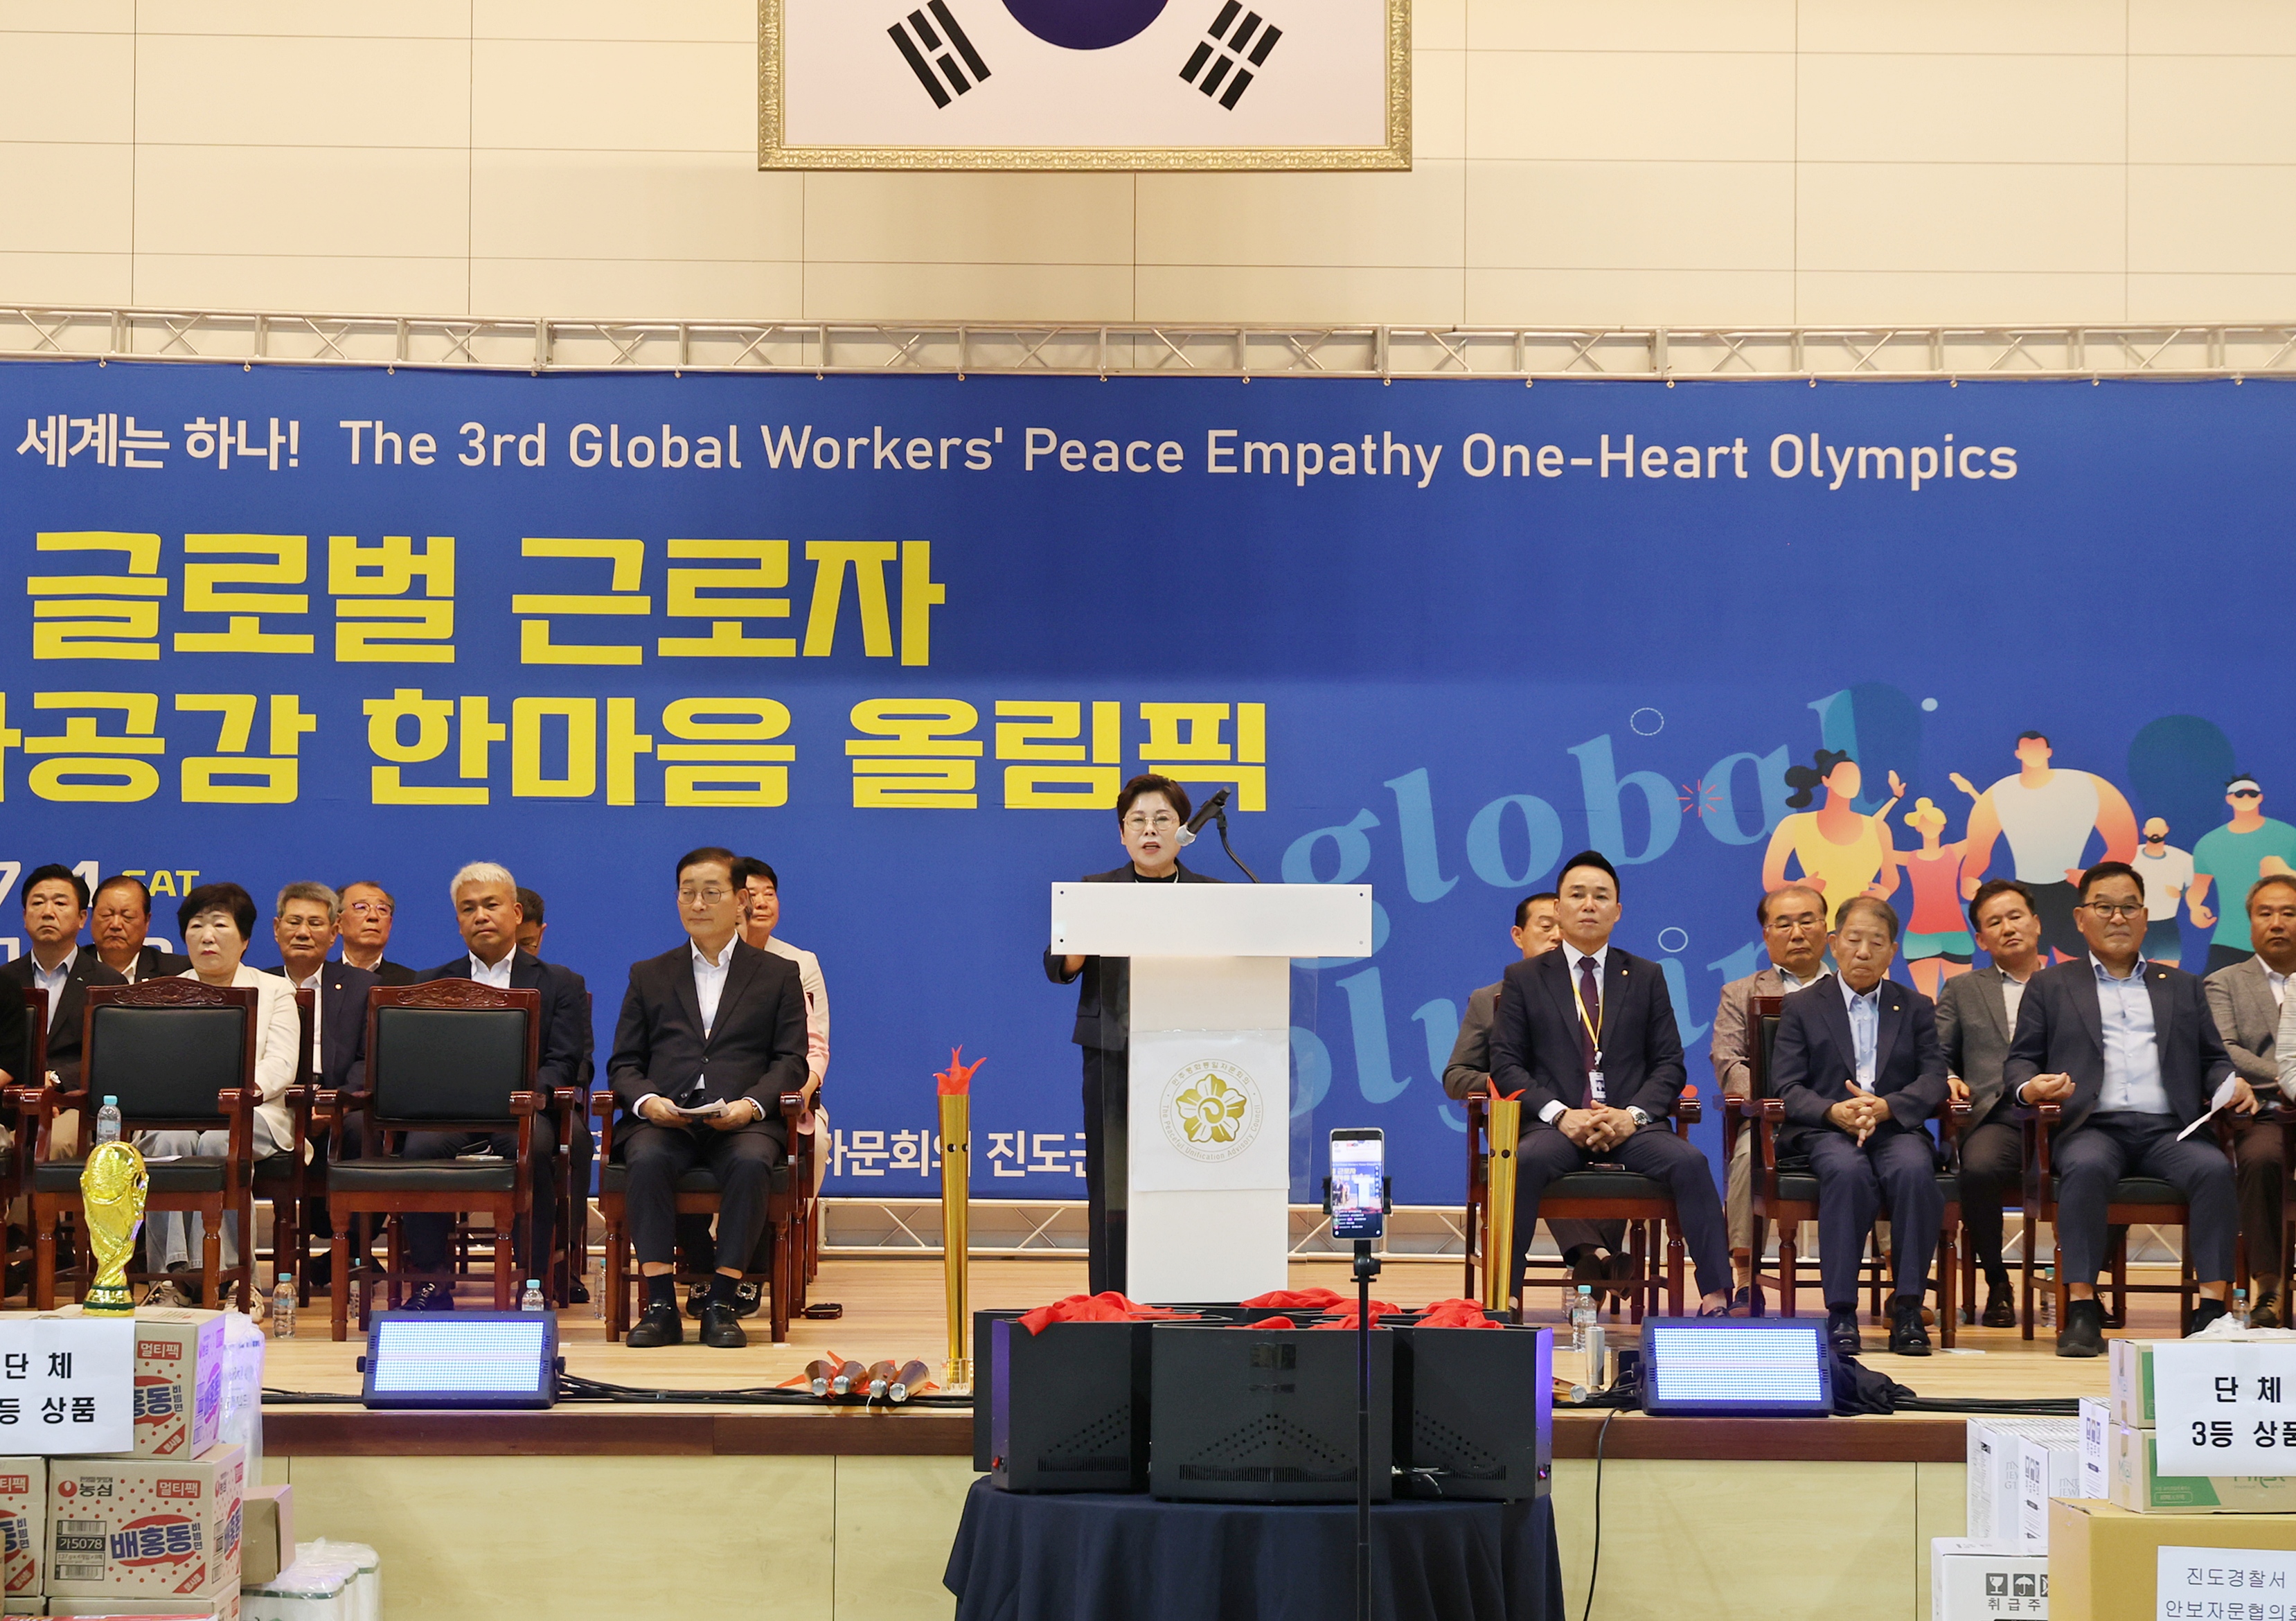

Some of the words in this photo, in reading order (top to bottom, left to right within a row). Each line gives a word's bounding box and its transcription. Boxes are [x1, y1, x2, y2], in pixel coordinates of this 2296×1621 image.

[16, 414, 170, 468] 세계는
[184, 417, 299, 470] 하나!
[339, 420, 436, 465] The
[458, 421, 546, 467] 3rd
[569, 423, 742, 469] Global
[760, 425, 1003, 470] Workers'
[1025, 427, 1184, 473] Peace
[1206, 429, 1443, 488] Empathy
[1461, 433, 1748, 480] One-Heart
[1769, 433, 2018, 491] Olympics
[27, 531, 454, 663] 글로벌
[512, 538, 945, 666] 근로자
[0, 689, 316, 804] 공감
[362, 689, 797, 808] 한마음
[845, 698, 1266, 812] 올림픽
[141, 1343, 179, 1358] 멀티팩
[41, 1397, 96, 1424] 상품
[2192, 1421, 2233, 1448] 3등
[79, 1483, 113, 1497] 농심
[160, 1482, 198, 1496] 멀티팩
[60, 1538, 103, 1550] 가5078
[110, 1525, 192, 1559] 배홍동
[2187, 1568, 2285, 1589] 진도경찰서
